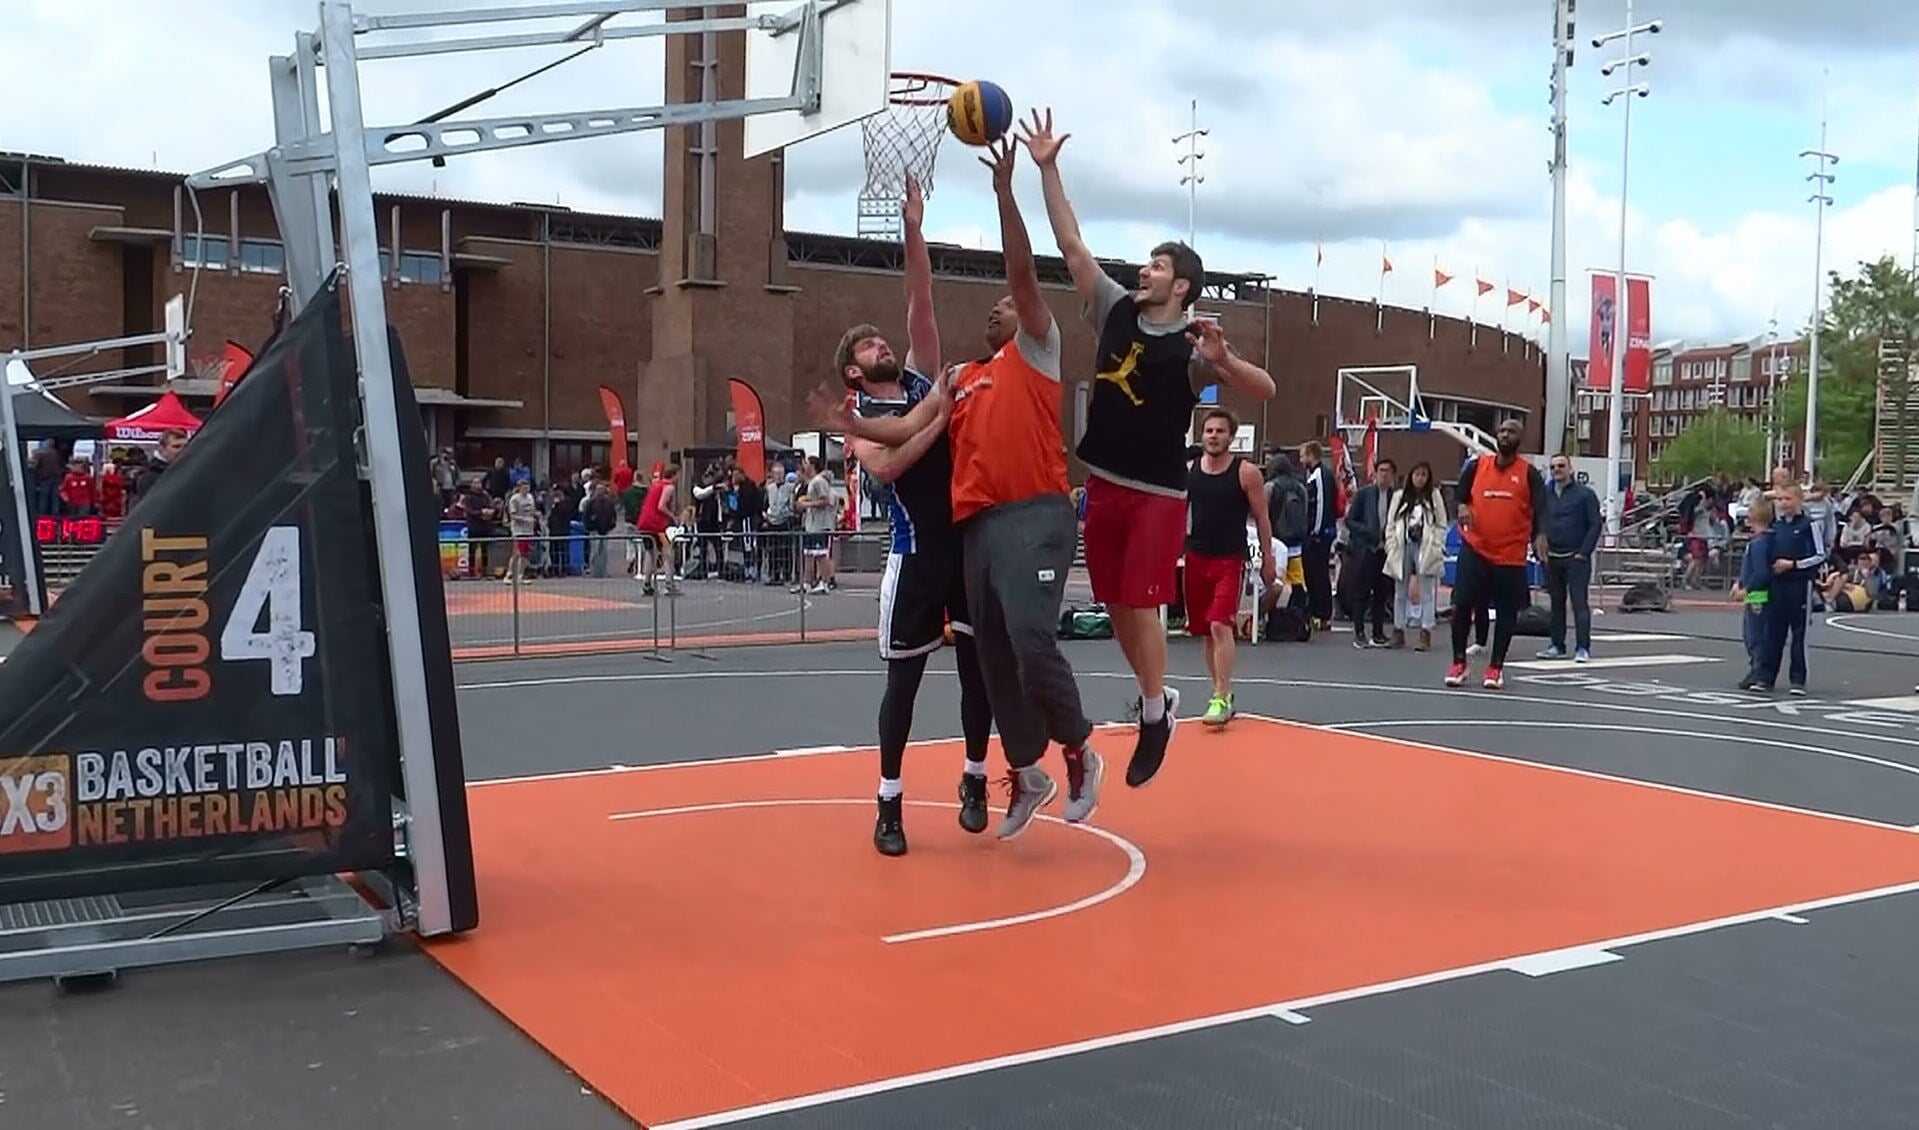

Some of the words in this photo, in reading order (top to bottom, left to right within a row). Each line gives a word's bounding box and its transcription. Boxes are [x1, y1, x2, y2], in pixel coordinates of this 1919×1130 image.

[142, 528, 211, 700] COURT
[221, 526, 316, 695] 4
[77, 737, 346, 801] BASKETBALL
[78, 784, 347, 846] NETHERLANDS
